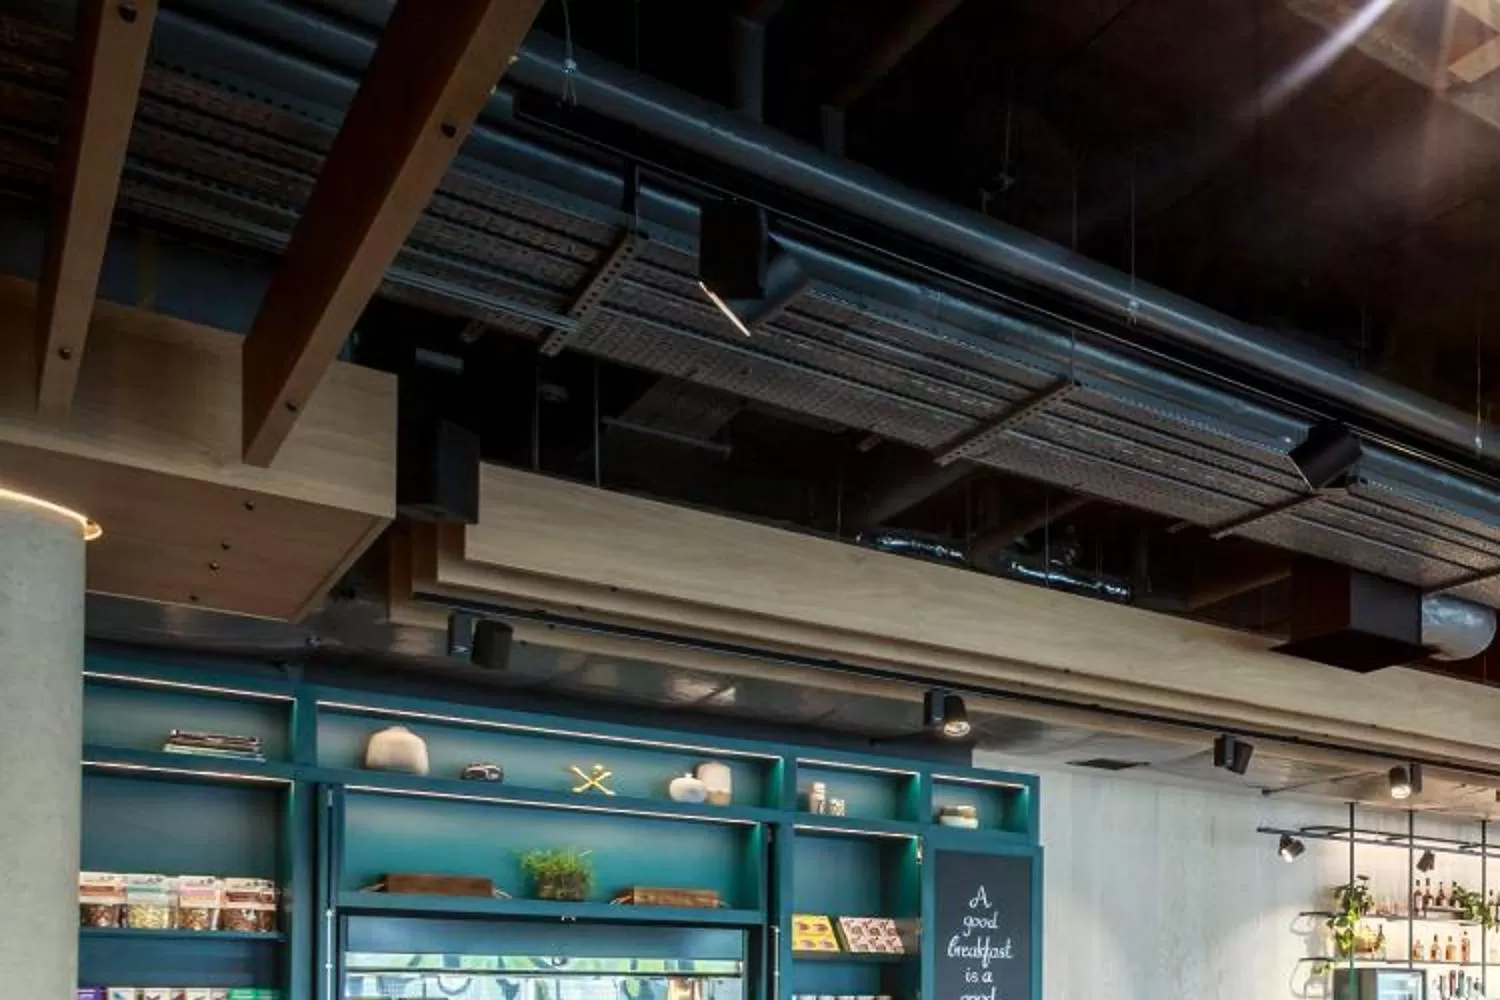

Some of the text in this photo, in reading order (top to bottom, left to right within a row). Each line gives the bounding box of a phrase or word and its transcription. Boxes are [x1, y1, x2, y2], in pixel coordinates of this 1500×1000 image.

[968, 884, 993, 909] A
[963, 910, 999, 937] good
[947, 934, 1014, 969] breakfast
[964, 967, 994, 984] is a
